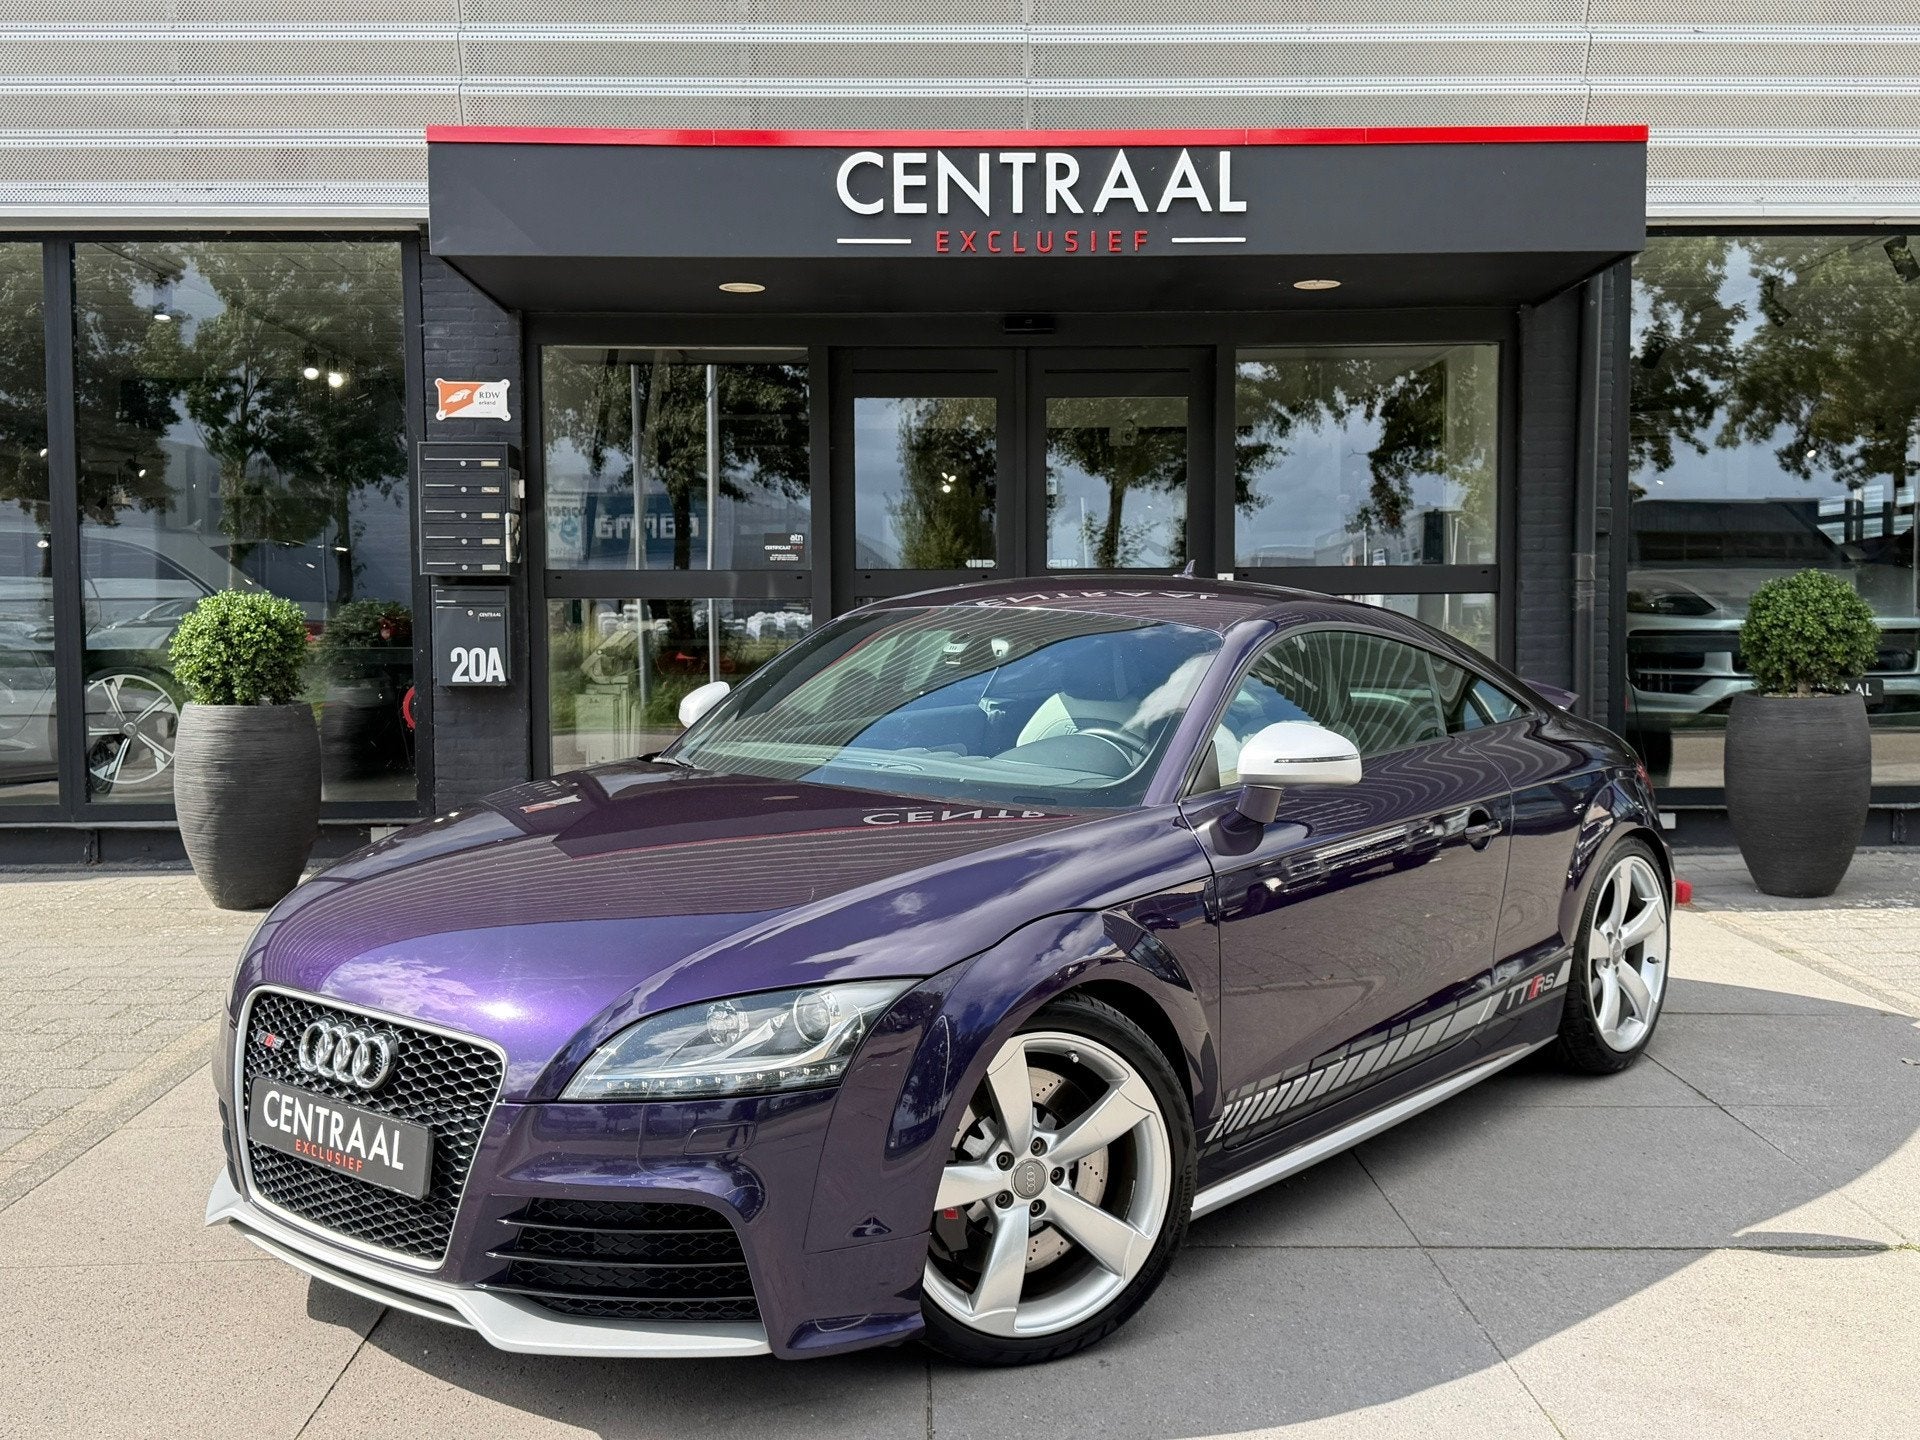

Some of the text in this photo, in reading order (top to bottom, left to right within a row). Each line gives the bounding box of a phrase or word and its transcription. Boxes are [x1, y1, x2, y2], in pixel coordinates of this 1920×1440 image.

[836, 148, 1247, 217] CENTRAAL
[935, 230, 1148, 253] EXCLUSIEF
[479, 391, 500, 399] RDW
[450, 646, 506, 682] 20A
[263, 1090, 404, 1171] CENTRAAL
[295, 1138, 363, 1173] EXCLUSIEF
